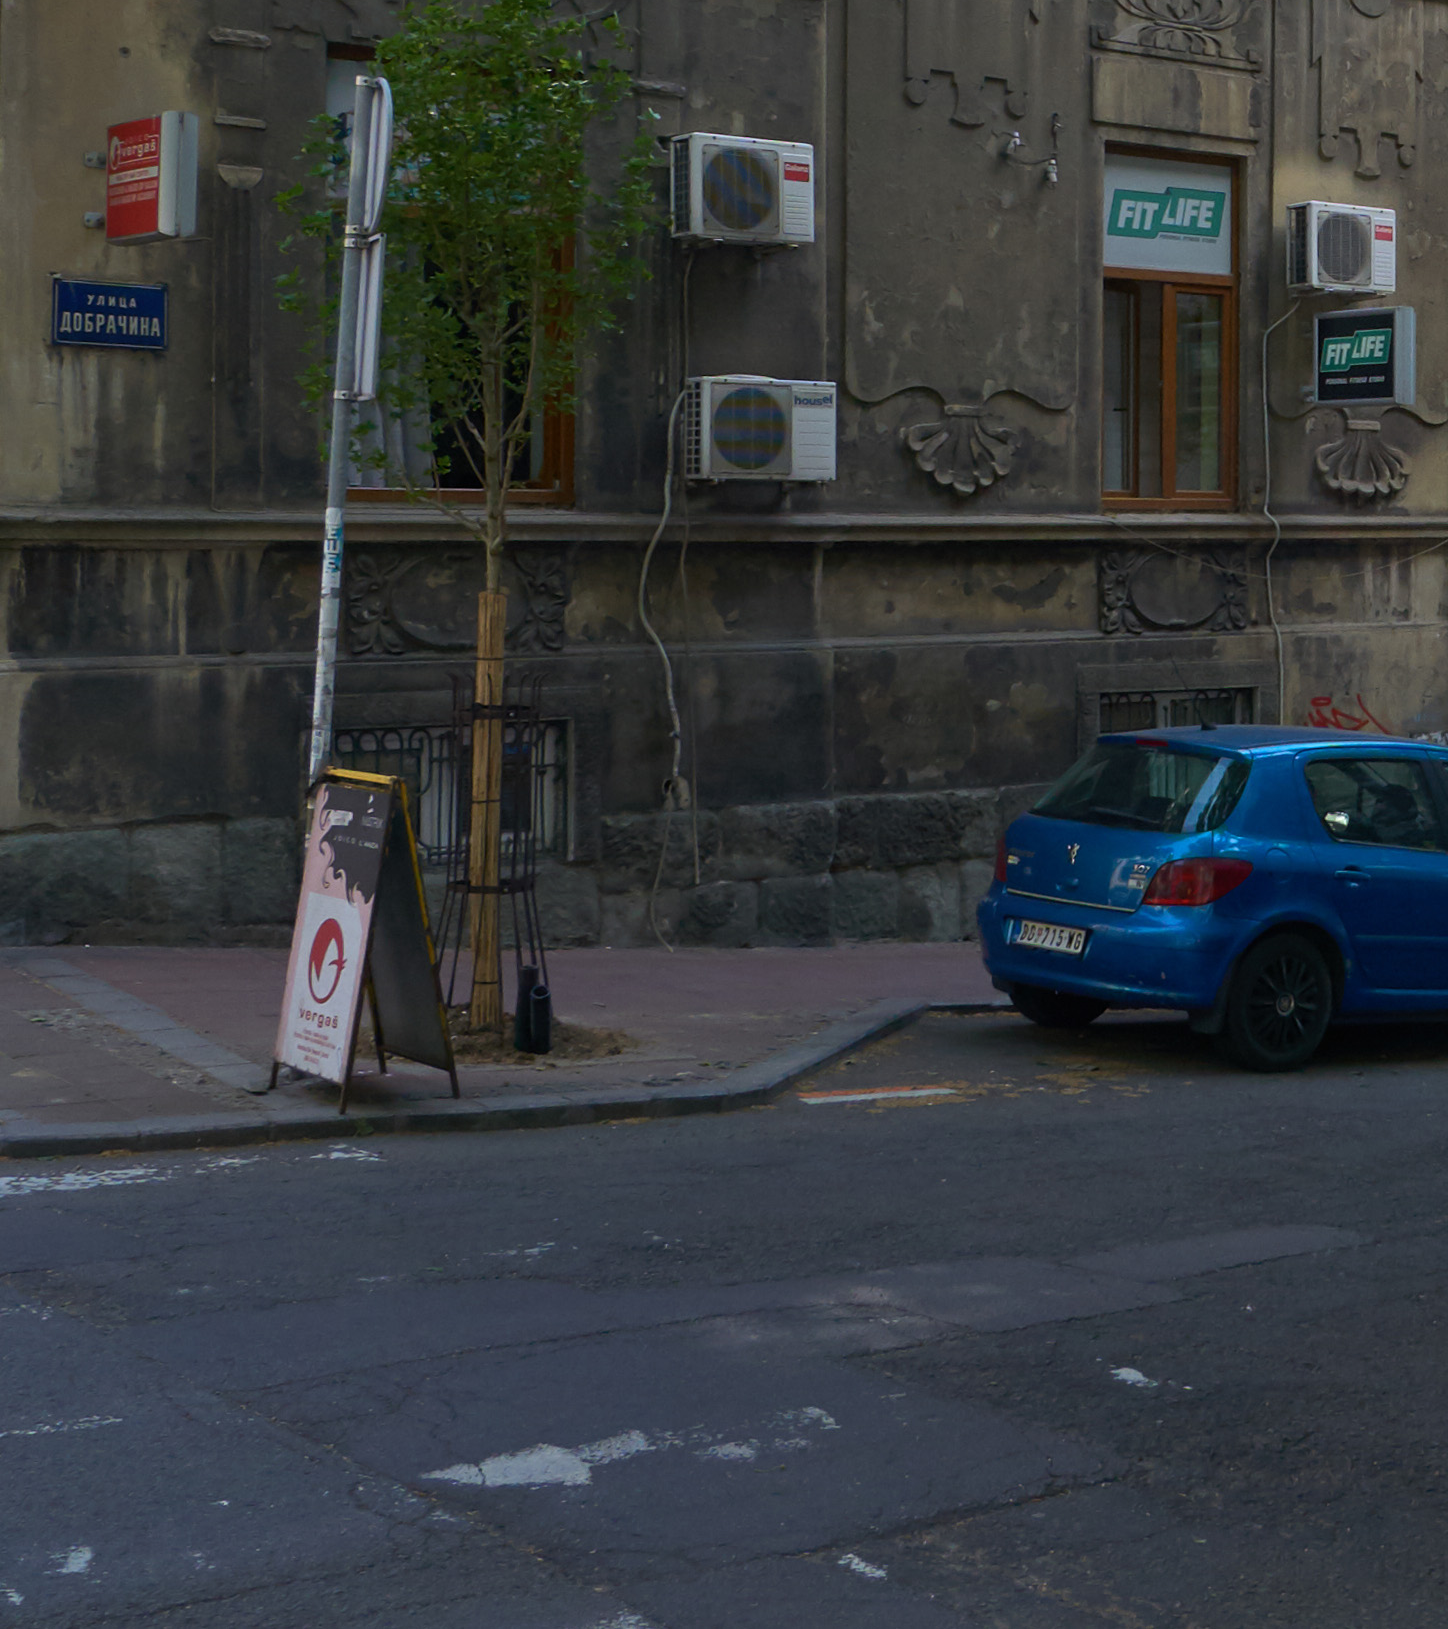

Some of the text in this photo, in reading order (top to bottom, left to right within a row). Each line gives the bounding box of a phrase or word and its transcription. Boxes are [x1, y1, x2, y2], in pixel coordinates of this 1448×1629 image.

[1117, 198, 1215, 230] FIT LIFE
[87, 294, 137, 308] УЛИЦА
[60, 311, 160, 337] ДОБРАЧИНА
[1325, 335, 1385, 366] FIT LIFE
[794, 394, 833, 406] housel
